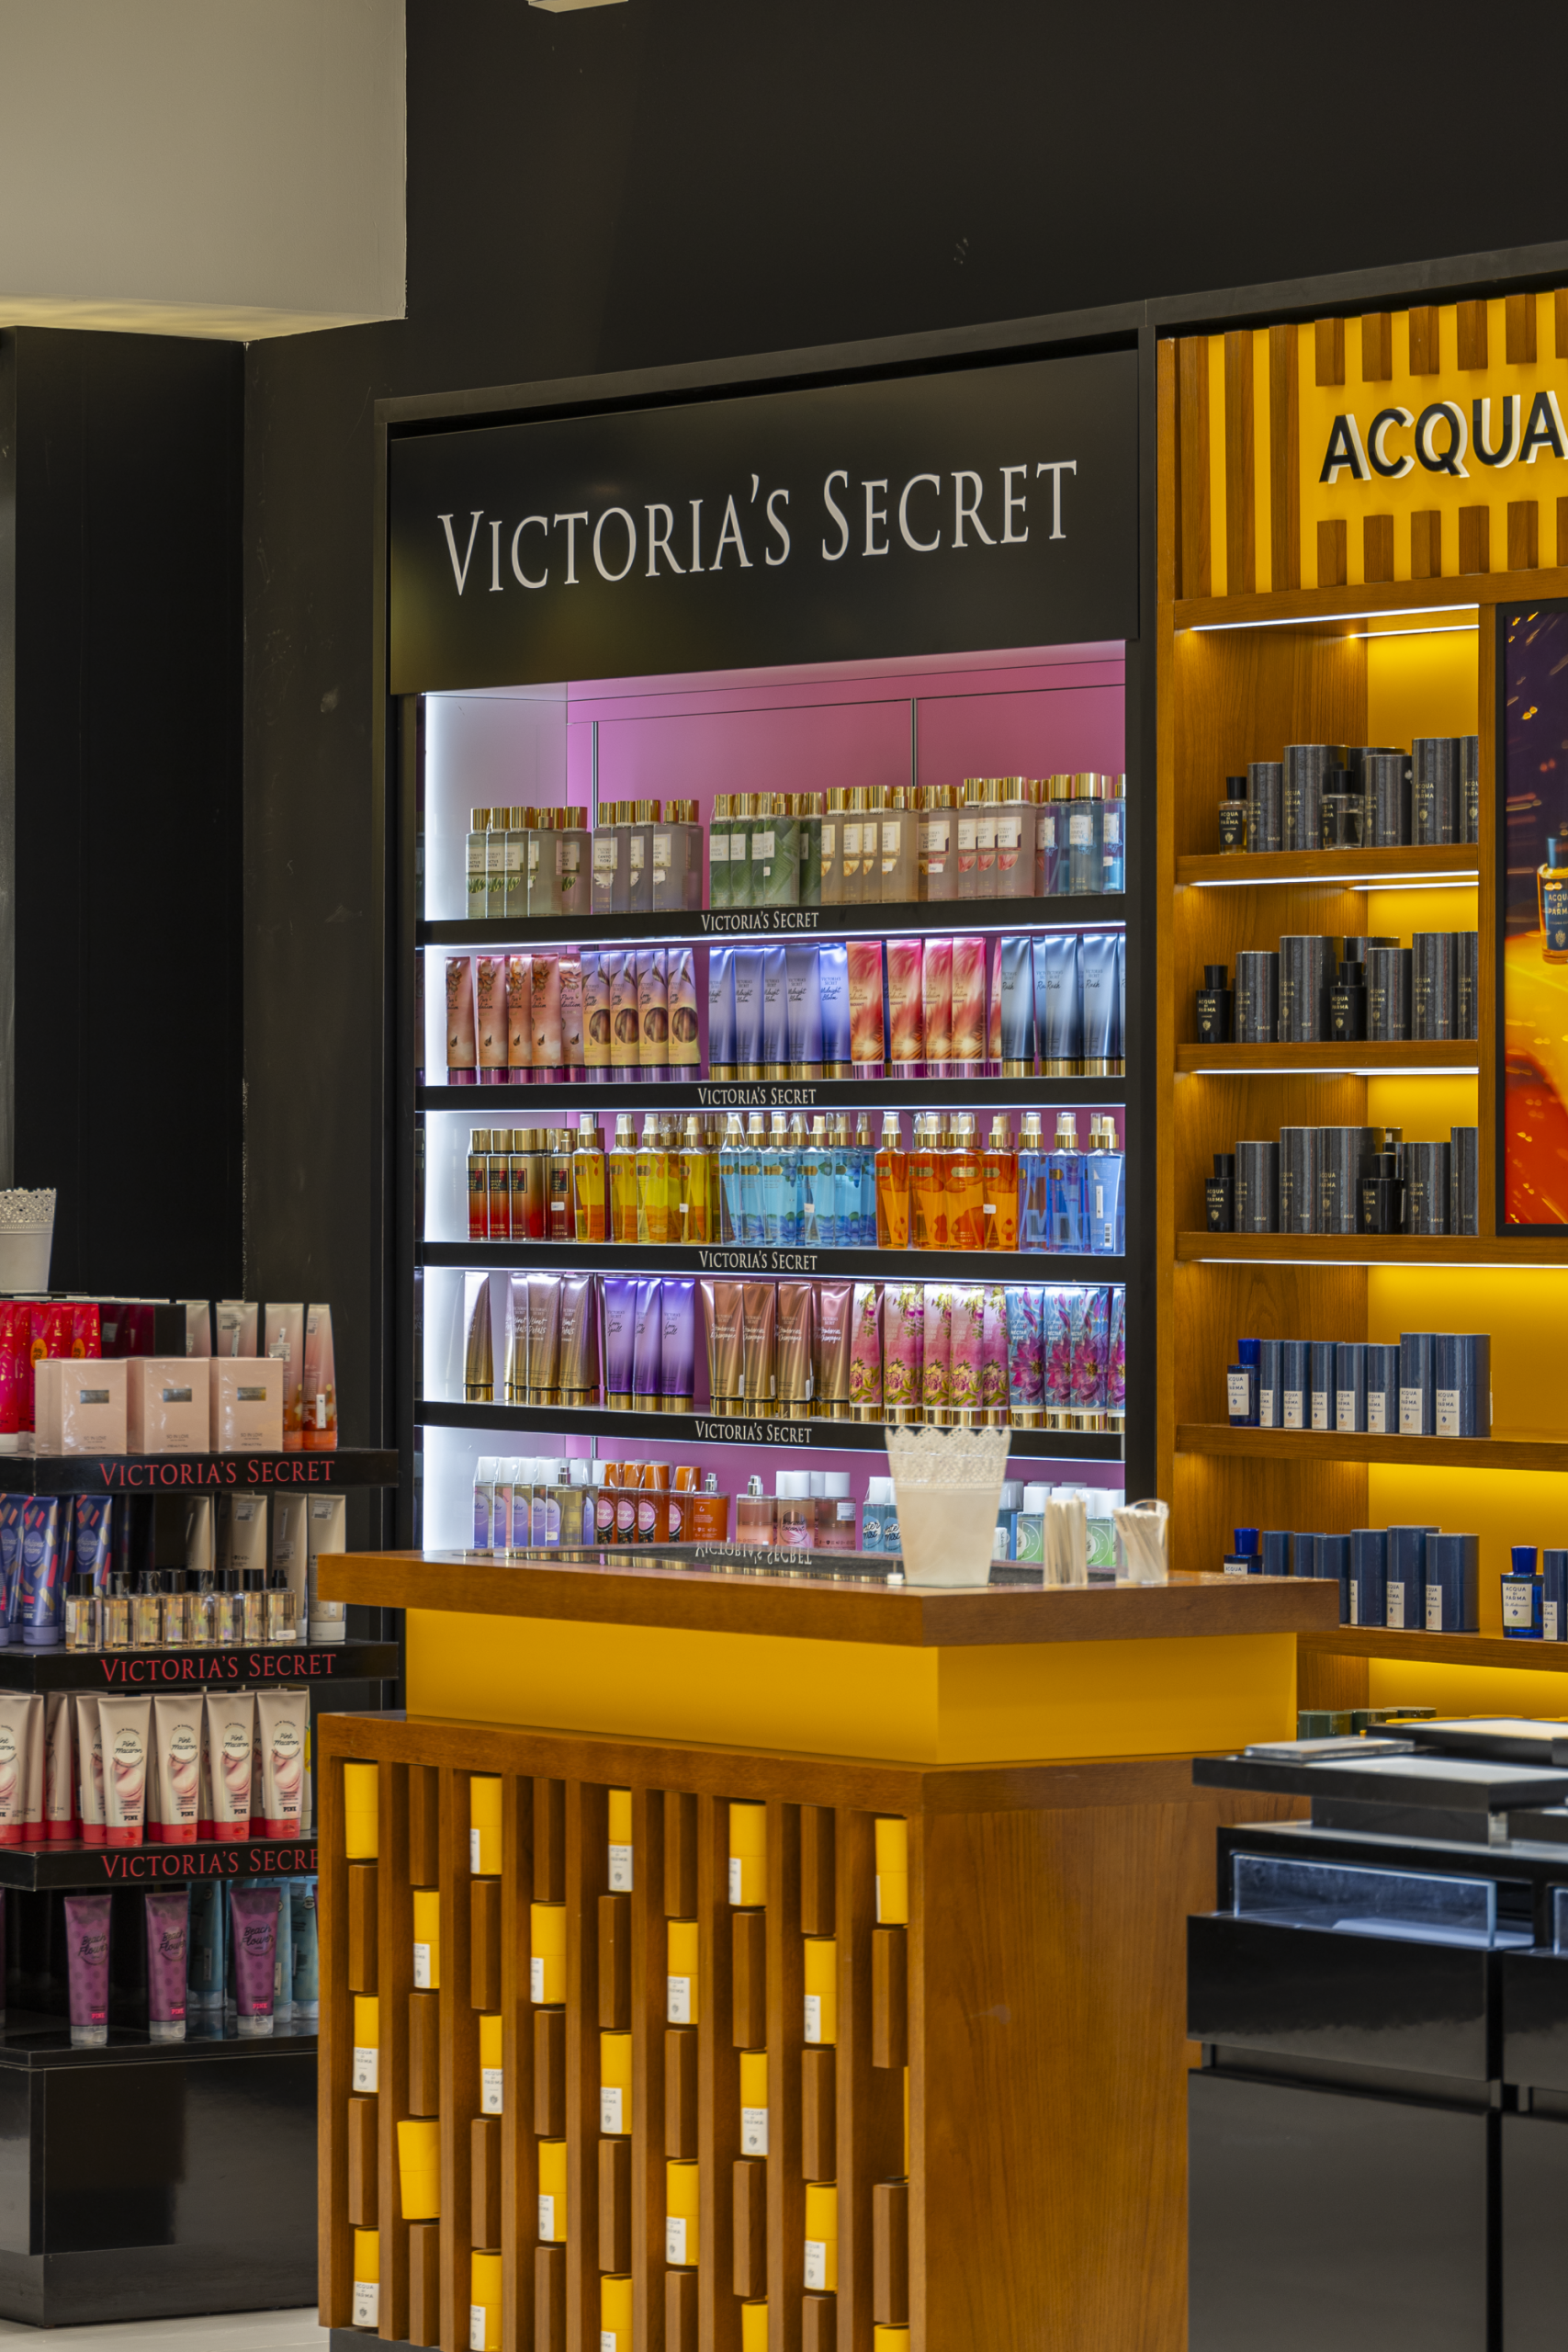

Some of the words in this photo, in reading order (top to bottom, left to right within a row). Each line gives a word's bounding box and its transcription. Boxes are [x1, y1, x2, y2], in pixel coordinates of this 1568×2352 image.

[1319, 390, 1568, 483] ACQUA
[437, 471, 791, 597] VICTORIA'S
[821, 459, 1077, 561] SECRET
[701, 910, 770, 932] VICTORIA'S
[773, 910, 819, 929] SECRET
[1002, 980, 1015, 990] Rush
[1047, 980, 1061, 989] Rush
[1085, 979, 1100, 989] Rush
[698, 1086, 766, 1105] VICTORIA'S
[771, 1087, 817, 1104] SECRET
[699, 1250, 768, 1269] VICTORIA'S
[772, 1251, 818, 1271] SECRET
[695, 1420, 762, 1441] VICTORIA'S
[766, 1424, 812, 1443] SECRET
[99, 1461, 237, 1487] VICTORIA'S
[247, 1459, 335, 1483] SECRET
[100, 1656, 239, 1682] VICTORIA'S
[249, 1653, 336, 1678] SECRET
[101, 1851, 239, 1879] VICTORIA'S
[250, 1849, 318, 1872] SECRE
[82, 1934, 107, 1946] Beach
[243, 1924, 272, 1936] Beach
[78, 1943, 107, 1956] Flower
[240, 1934, 274, 1947] Flower
